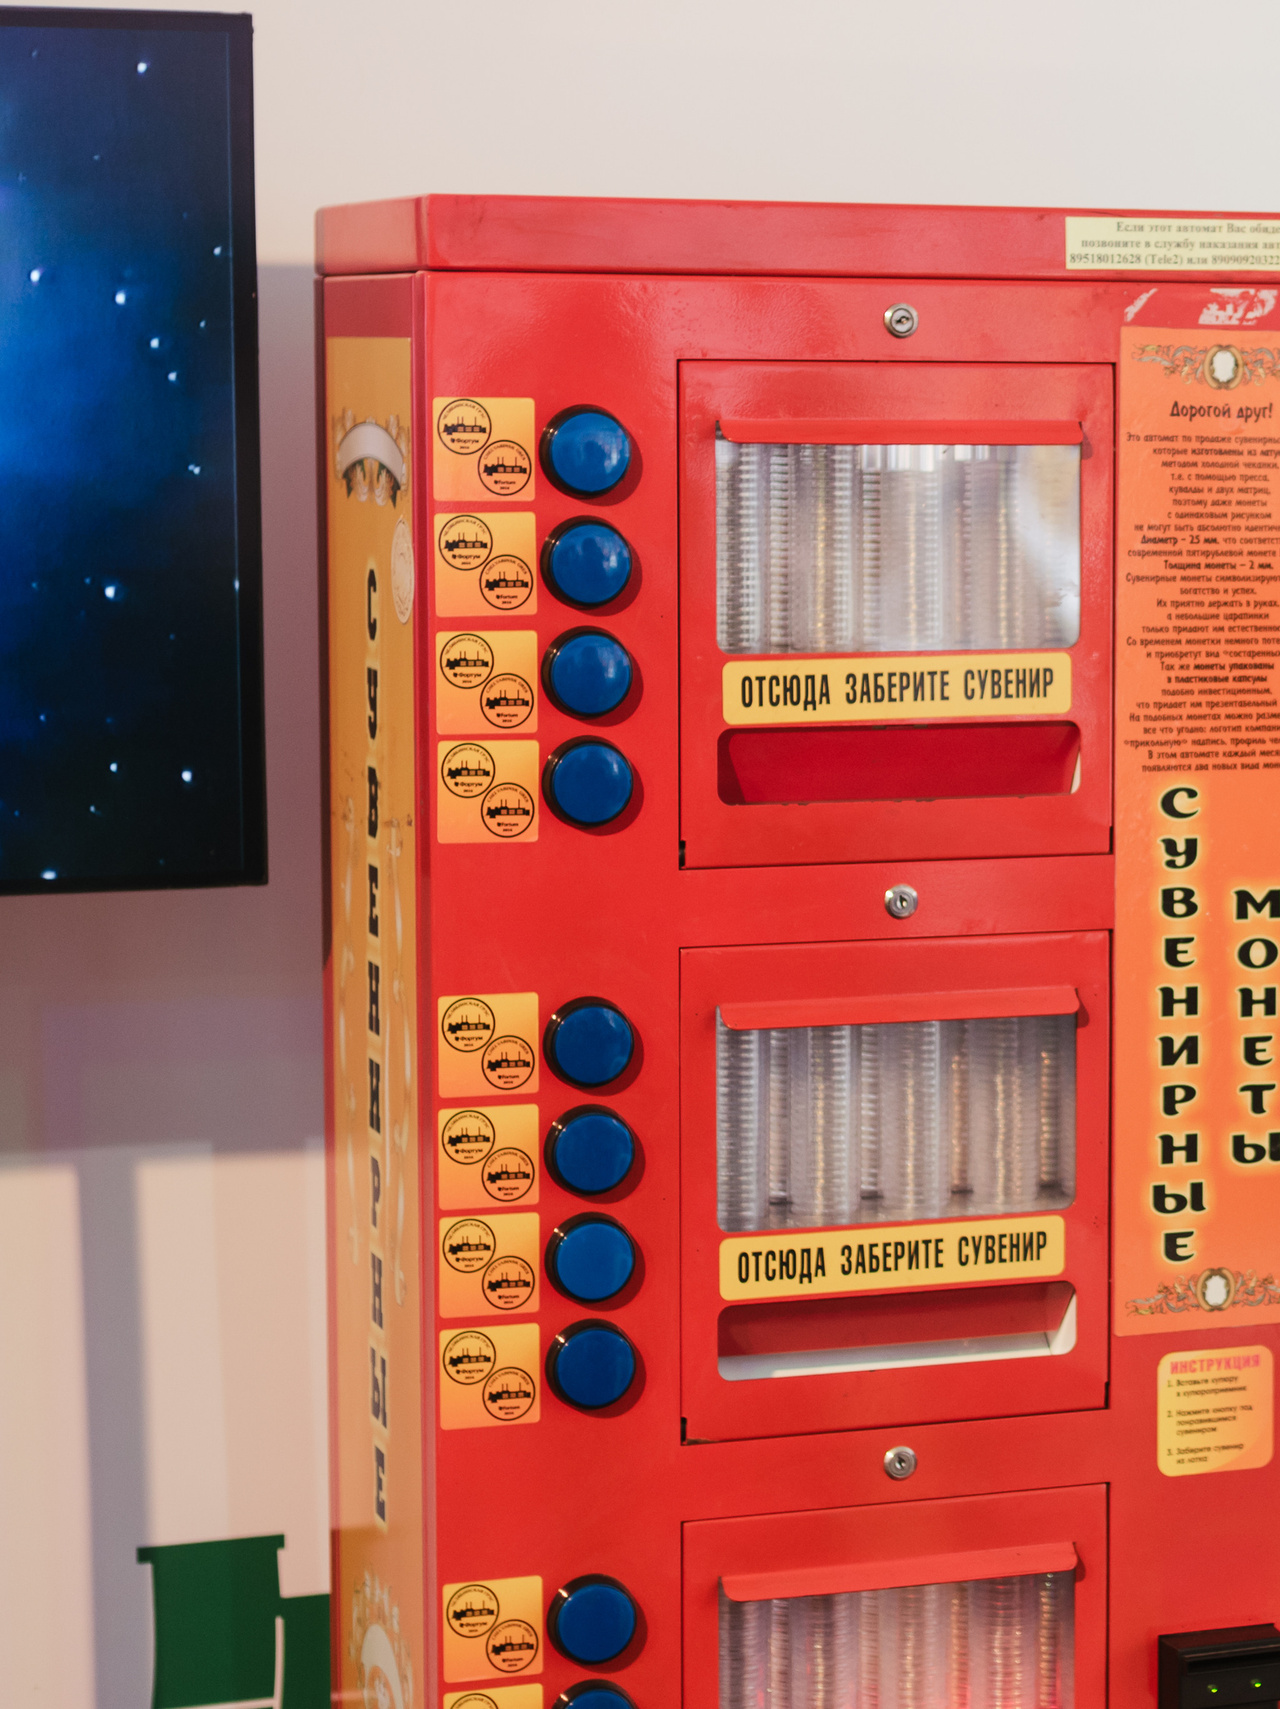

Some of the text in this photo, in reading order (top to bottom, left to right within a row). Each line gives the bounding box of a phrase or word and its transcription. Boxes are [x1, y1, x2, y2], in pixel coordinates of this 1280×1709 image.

[1116, 221, 1144, 231] Если
[1149, 224, 1172, 232] этот
[1227, 223, 1245, 233] Вас
[1081, 238, 1140, 249] позвоните
[1154, 238, 1194, 250] службу
[1144, 253, 1183, 264] (Tele2)
[1169, 401, 1272, 422] Дорогой друг!
[1127, 432, 1140, 441] Это
[1195, 435, 1231, 444] продаже
[1152, 447, 1188, 456] которые
[1194, 473, 1236, 481] помощью
[1169, 486, 1204, 494] кувалды
[1215, 486, 1234, 495] двух
[1172, 498, 1207, 507] поэтому
[1231, 512, 1271, 520] рисунком
[1147, 524, 1171, 533] могут
[1174, 524, 1194, 533] быть
[1141, 535, 1178, 545] Диаметр
[1189, 534, 1200, 544] 25
[1127, 549, 1183, 559] современной
[1186, 549, 1243, 558] пятирублевой
[1164, 560, 1201, 570] Толщина
[1125, 573, 1176, 583] Сувенирные
[1215, 575, 1280, 583] символизируют
[1156, 598, 1167, 606] Их
[1170, 600, 1205, 608] приятно
[1207, 600, 1243, 609] держать
[1223, 612, 1269, 621] царапинки
[1172, 625, 1209, 634] придают
[1126, 636, 1137, 645] Со
[1140, 638, 1182, 647] временем
[1155, 651, 1201, 661] приобретут
[1160, 660, 1174, 670] Так
[1228, 662, 1274, 671] упакованы
[1232, 675, 1267, 683] капсулы
[741, 667, 1054, 711] ОТСЮДА ЗАБЕРИТЕ СУВЕНИР
[1153, 701, 1186, 710] придает
[1205, 700, 1277, 709] презентабельный
[1129, 713, 1140, 721] На
[1230, 737, 1266, 746] профиль
[1222, 749, 1256, 757] каждый
[1152, 786, 1206, 1262] СУВЕНИРНЫЕ
[366, 568, 388, 1524] СУВЕНИРНЫЕ
[738, 1230, 1047, 1284] ОТСЮДА ЗАБЕРИТЕ СУВЕНИР
[1170, 1354, 1260, 1375] ИНСТРУКЦИЯ
